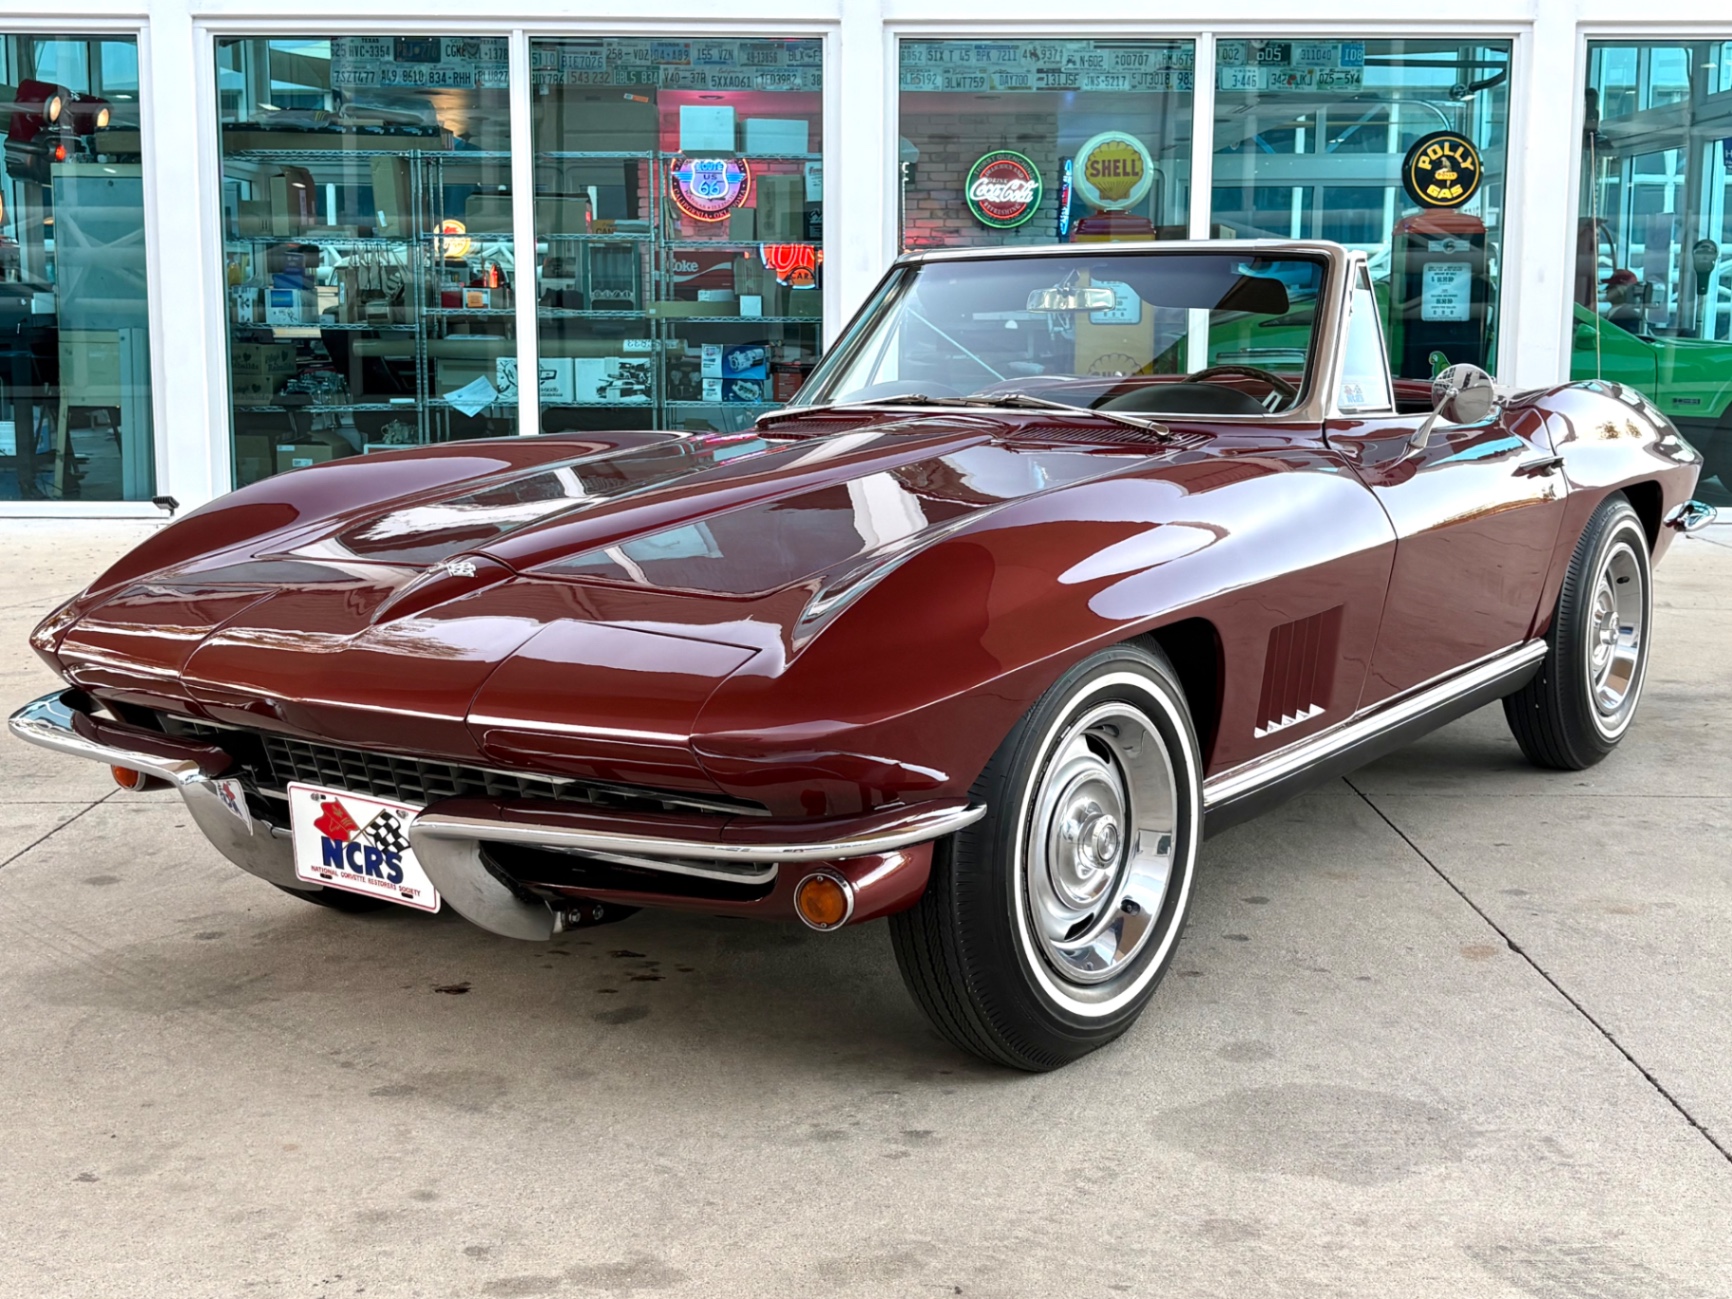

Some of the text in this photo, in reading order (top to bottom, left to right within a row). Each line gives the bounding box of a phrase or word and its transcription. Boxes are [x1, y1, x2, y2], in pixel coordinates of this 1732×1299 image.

[1090, 159, 1139, 177] SHELL
[1418, 142, 1474, 171] POLLY
[699, 182, 720, 195] 66
[970, 177, 1039, 202] Coca-Cola
[1427, 184, 1463, 199] GAS
[321, 836, 403, 884] NCRS
[311, 865, 421, 897] NATIONAL CORVETTE RESTORERS SOCIETY
